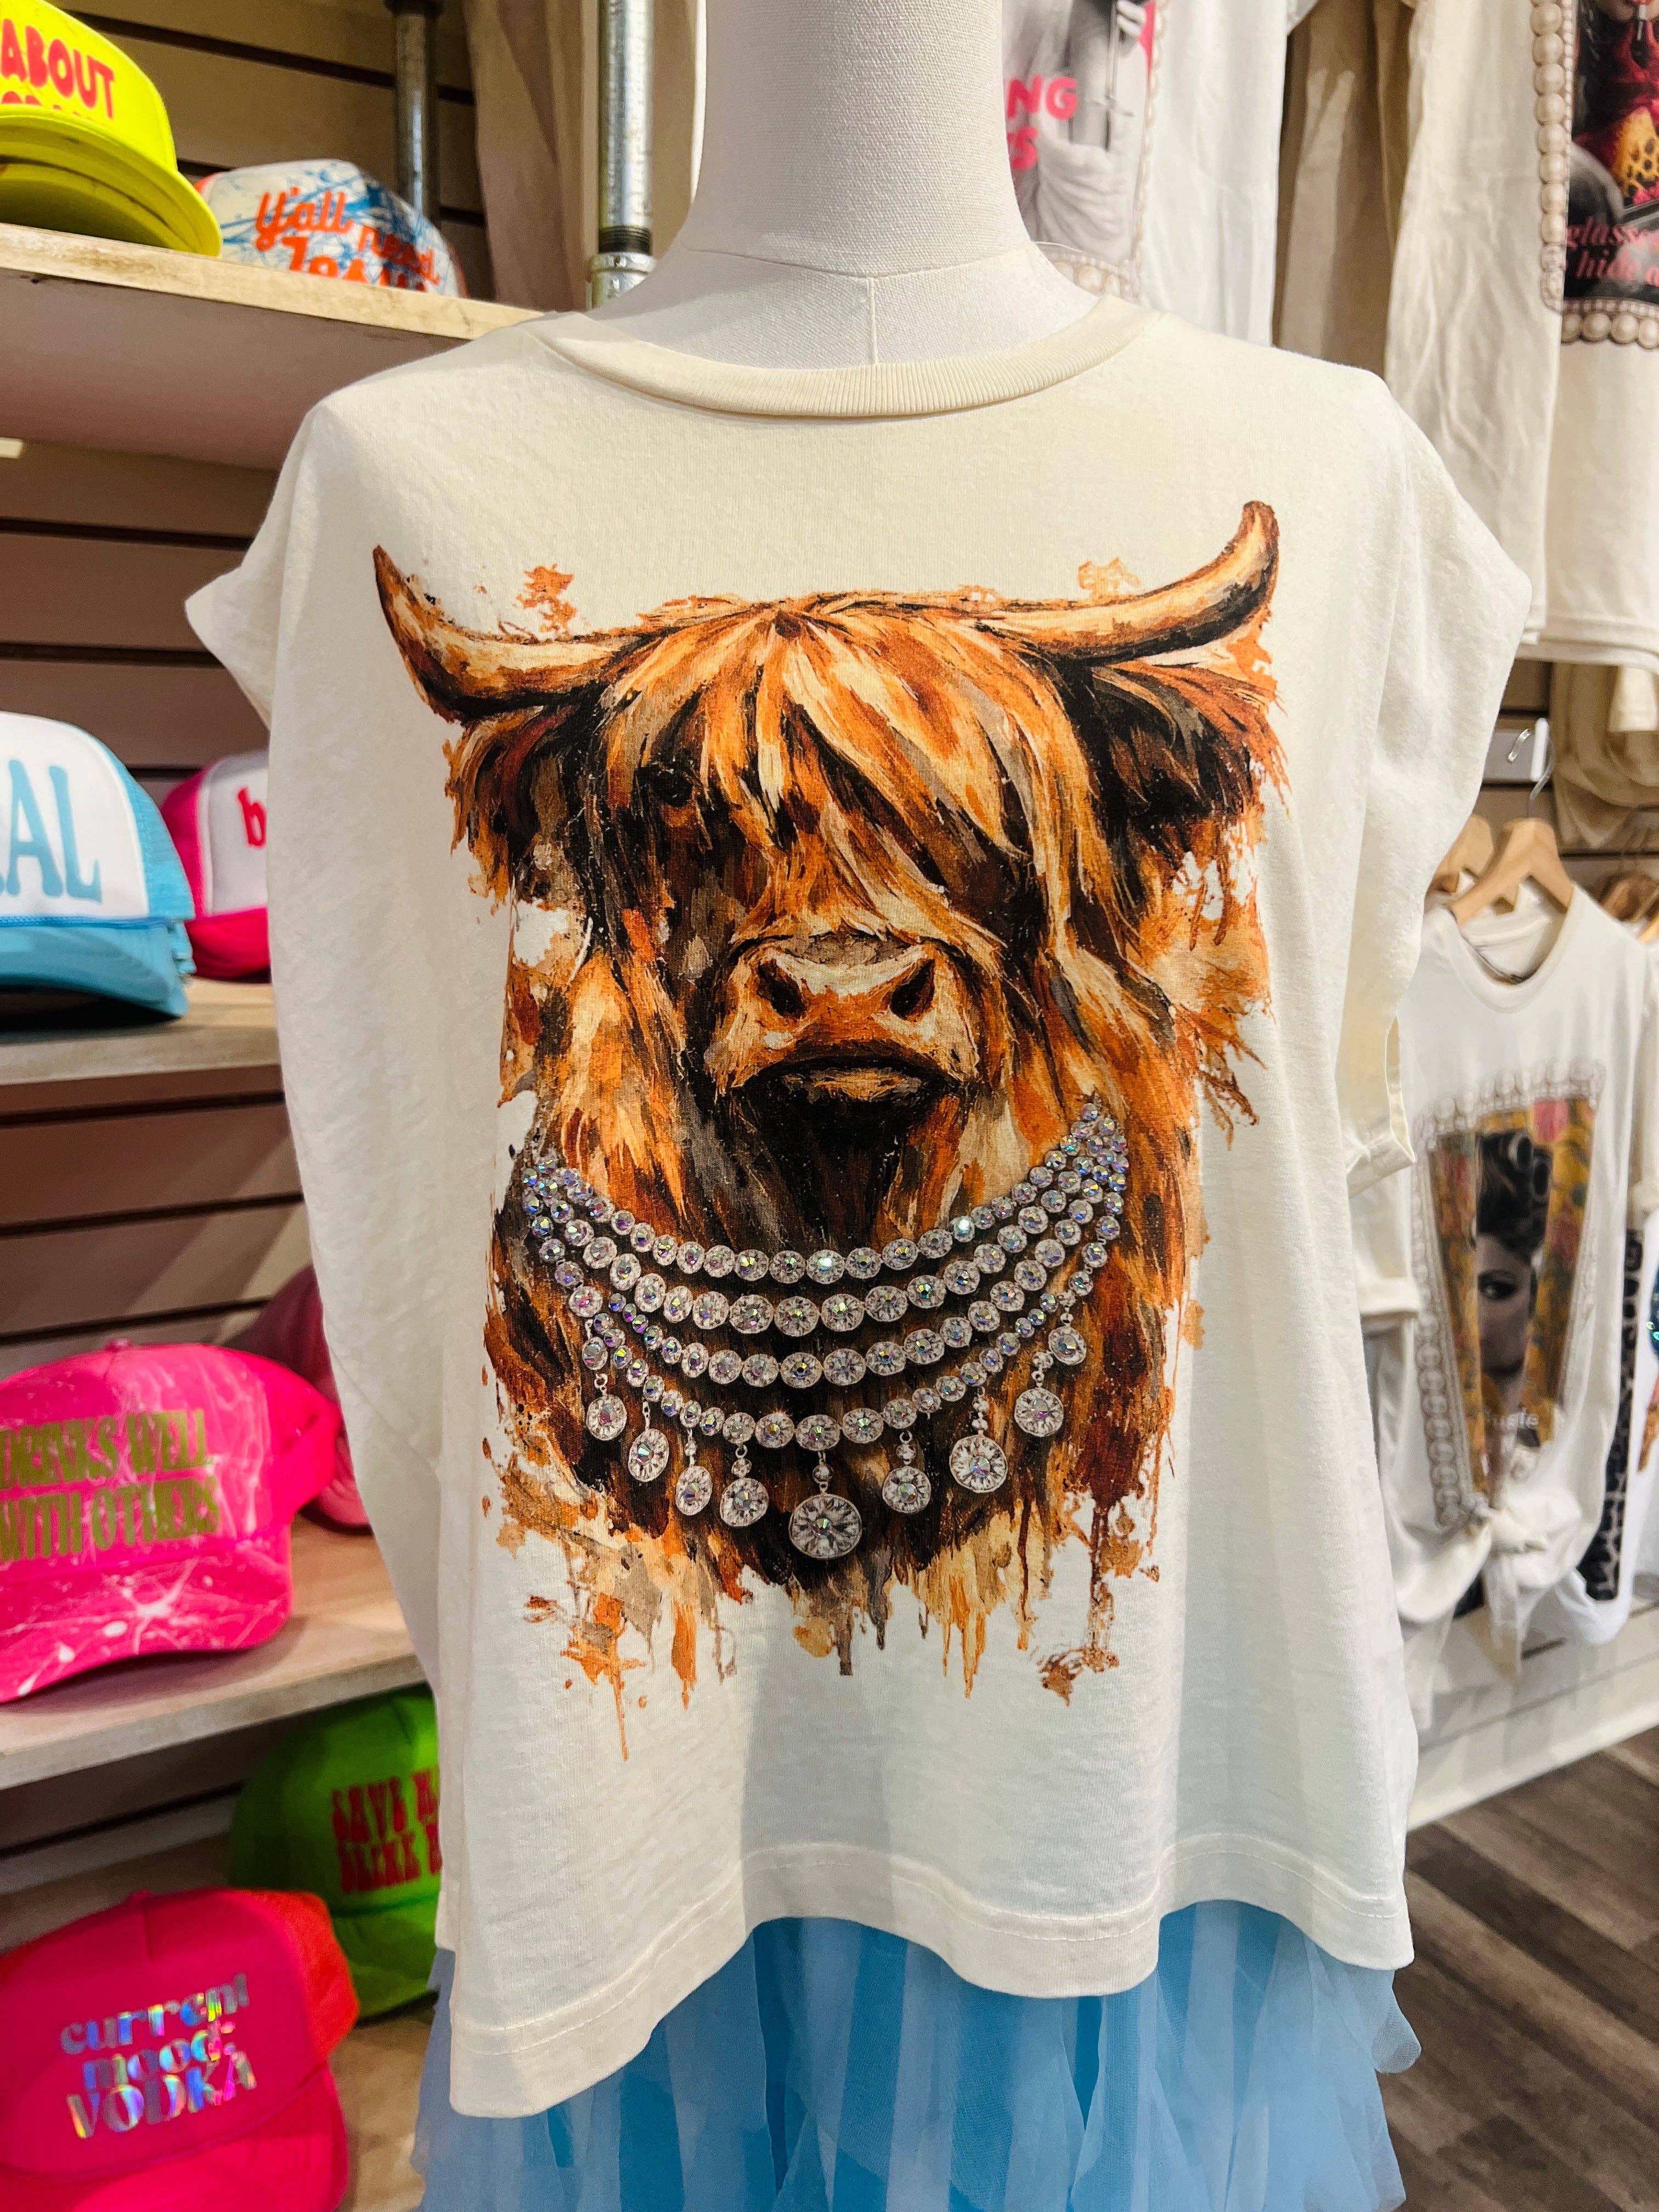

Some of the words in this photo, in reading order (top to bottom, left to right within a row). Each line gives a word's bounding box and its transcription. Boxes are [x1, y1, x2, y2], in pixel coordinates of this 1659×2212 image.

[1, 19, 115, 120] ABOUT
[255, 187, 354, 251] Y'all
[0, 759, 103, 905] AL
[126, 1409, 206, 1474] WELL
[91, 1476, 219, 1550] OTHERS
[60, 1972, 250, 2055] current
[66, 2051, 257, 2138] VODKA
